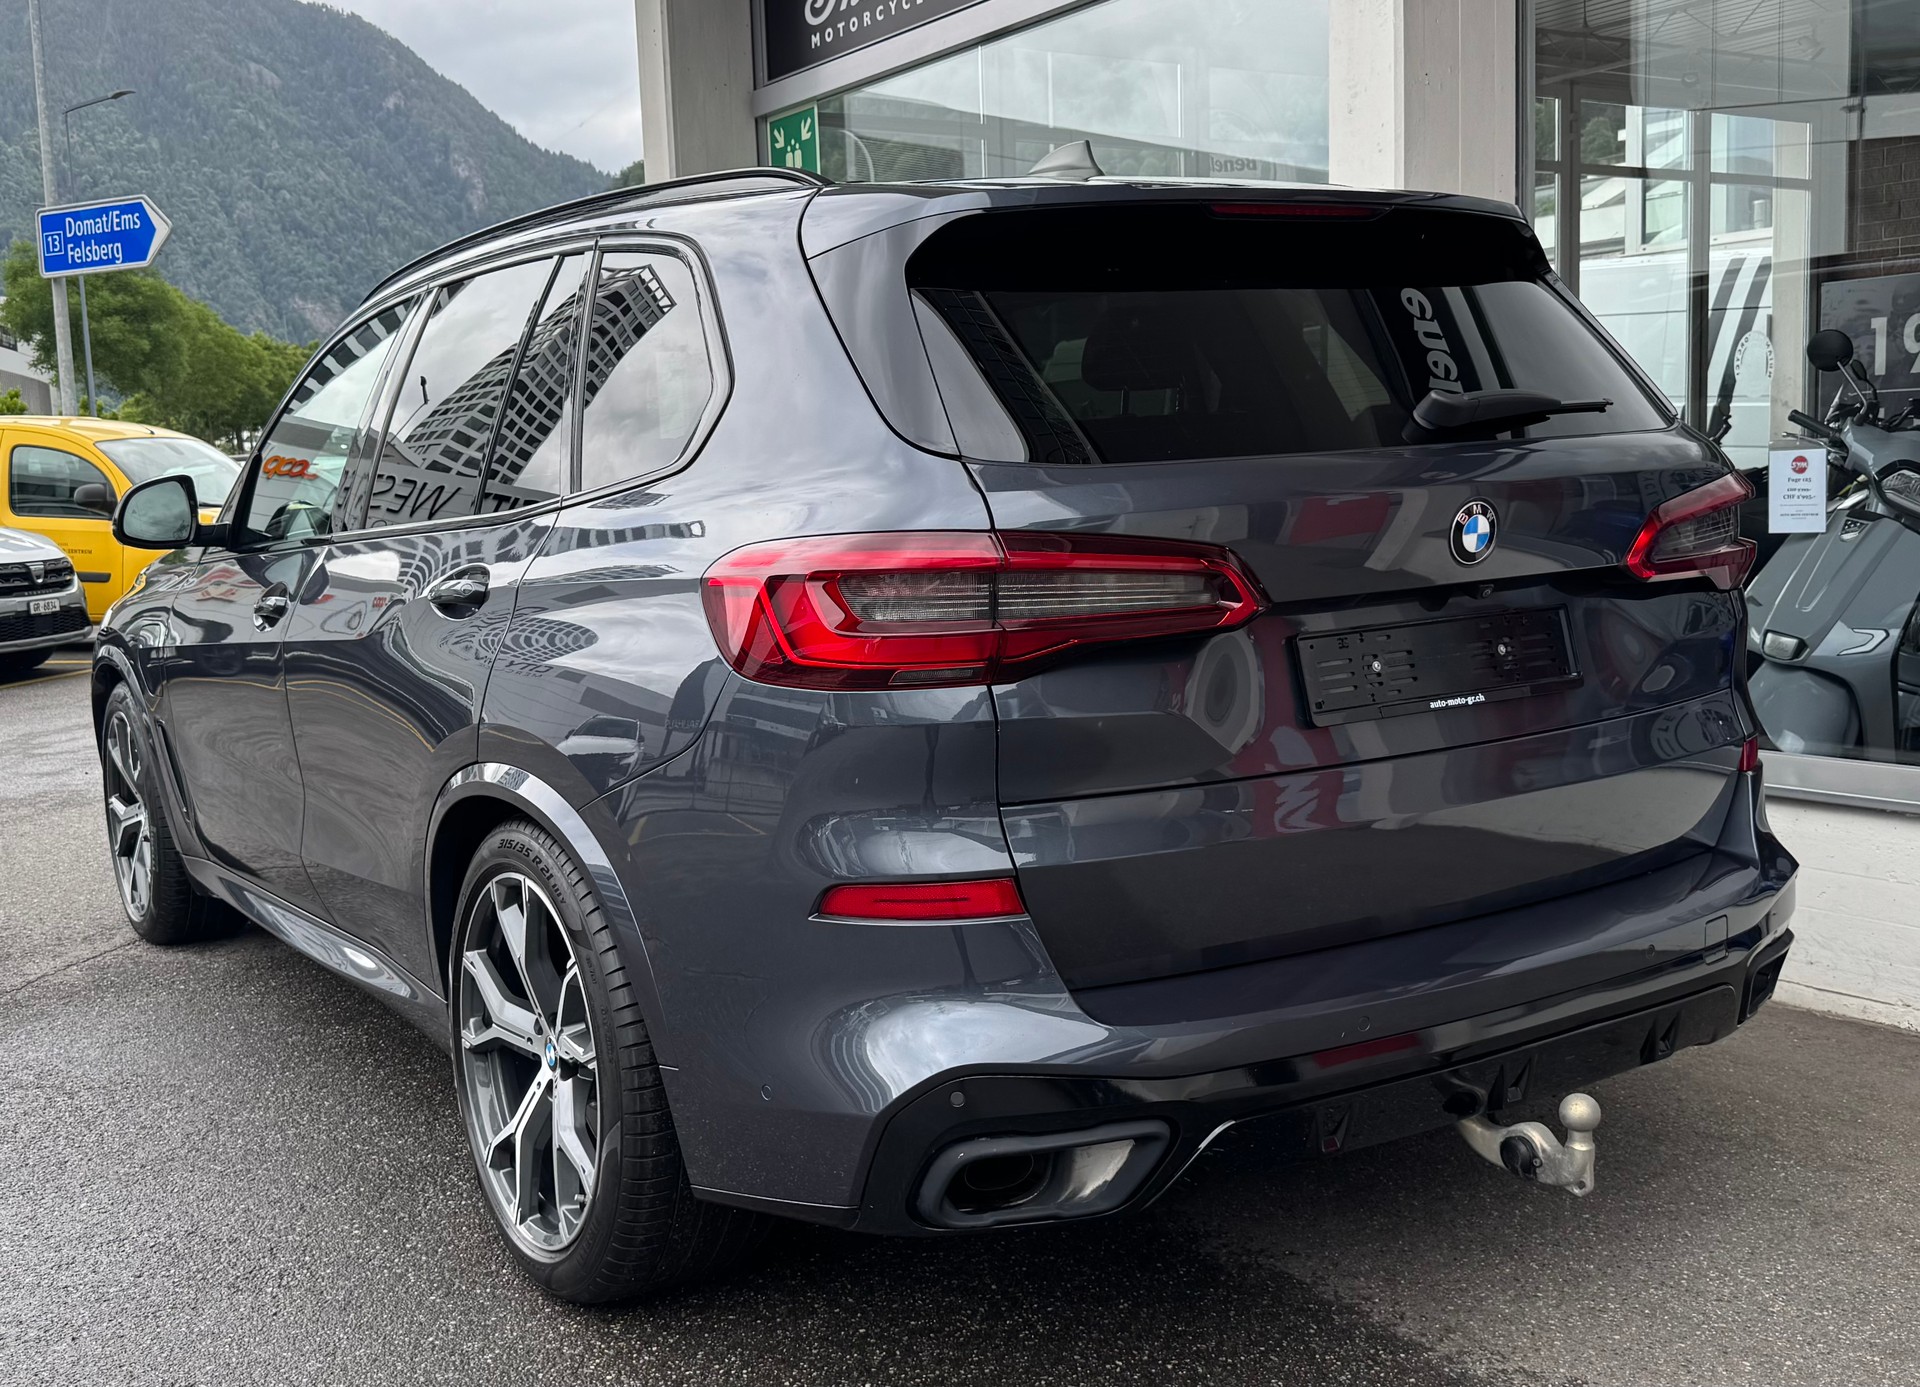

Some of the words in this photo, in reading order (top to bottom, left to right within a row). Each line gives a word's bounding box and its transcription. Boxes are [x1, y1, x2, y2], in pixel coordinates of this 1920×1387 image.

[65, 210, 141, 237] Domat/Ems
[47, 235, 61, 252] 13
[67, 240, 123, 264] Felsberg
[1457, 504, 1494, 526] BMW
[1430, 693, 1486, 709] auto-moto-gr.ch
[498, 839, 533, 858] 315/35
